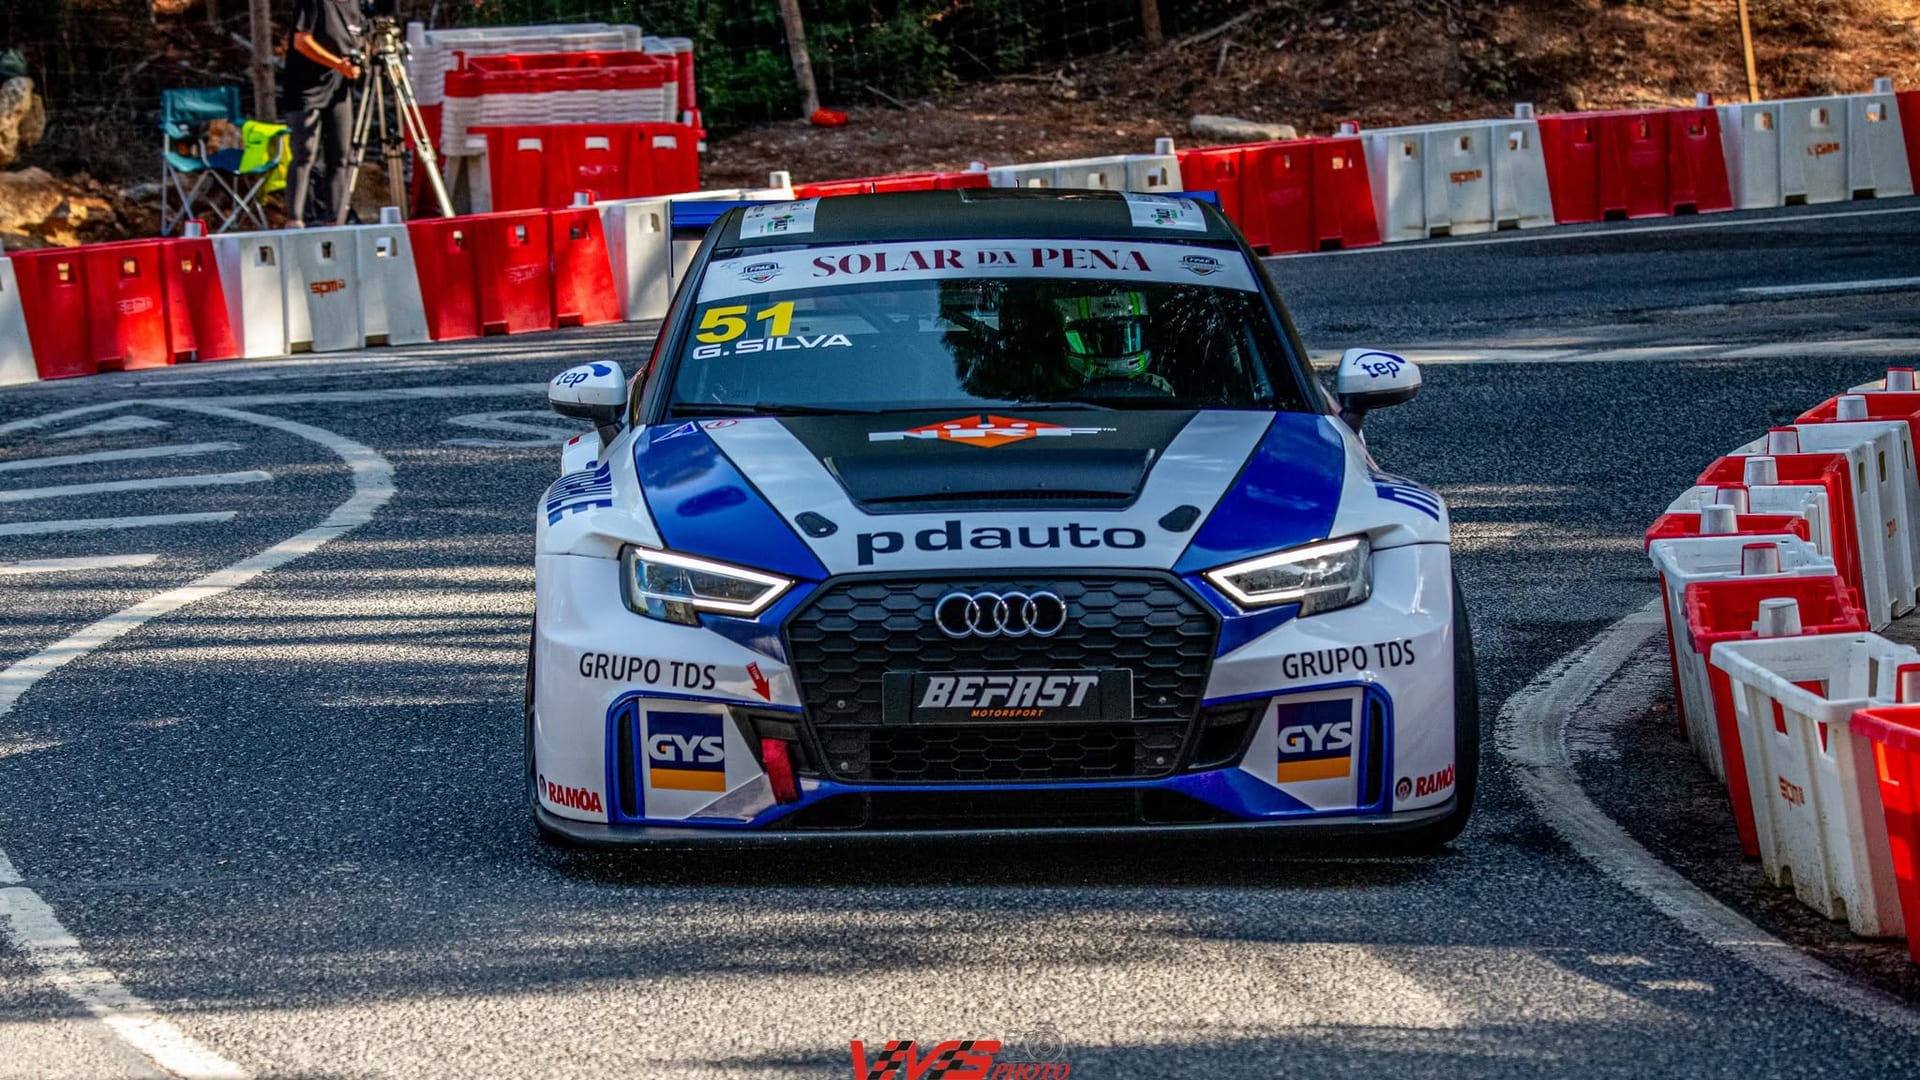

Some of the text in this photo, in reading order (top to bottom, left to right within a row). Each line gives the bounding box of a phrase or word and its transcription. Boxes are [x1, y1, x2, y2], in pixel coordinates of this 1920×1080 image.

[813, 248, 1152, 277] SOLAR DA PENA
[696, 301, 795, 343] 51
[693, 334, 853, 360] G.SILVA
[556, 372, 589, 388] tep
[1361, 361, 1400, 379] tep
[579, 652, 716, 690] GRUPO TDS
[1282, 639, 1416, 679] GRUPO TDS
[918, 676, 1100, 708] BEFAST
[971, 708, 1045, 718] MOTORSPORT
[648, 734, 725, 763] GYS
[1278, 721, 1352, 753] GYS
